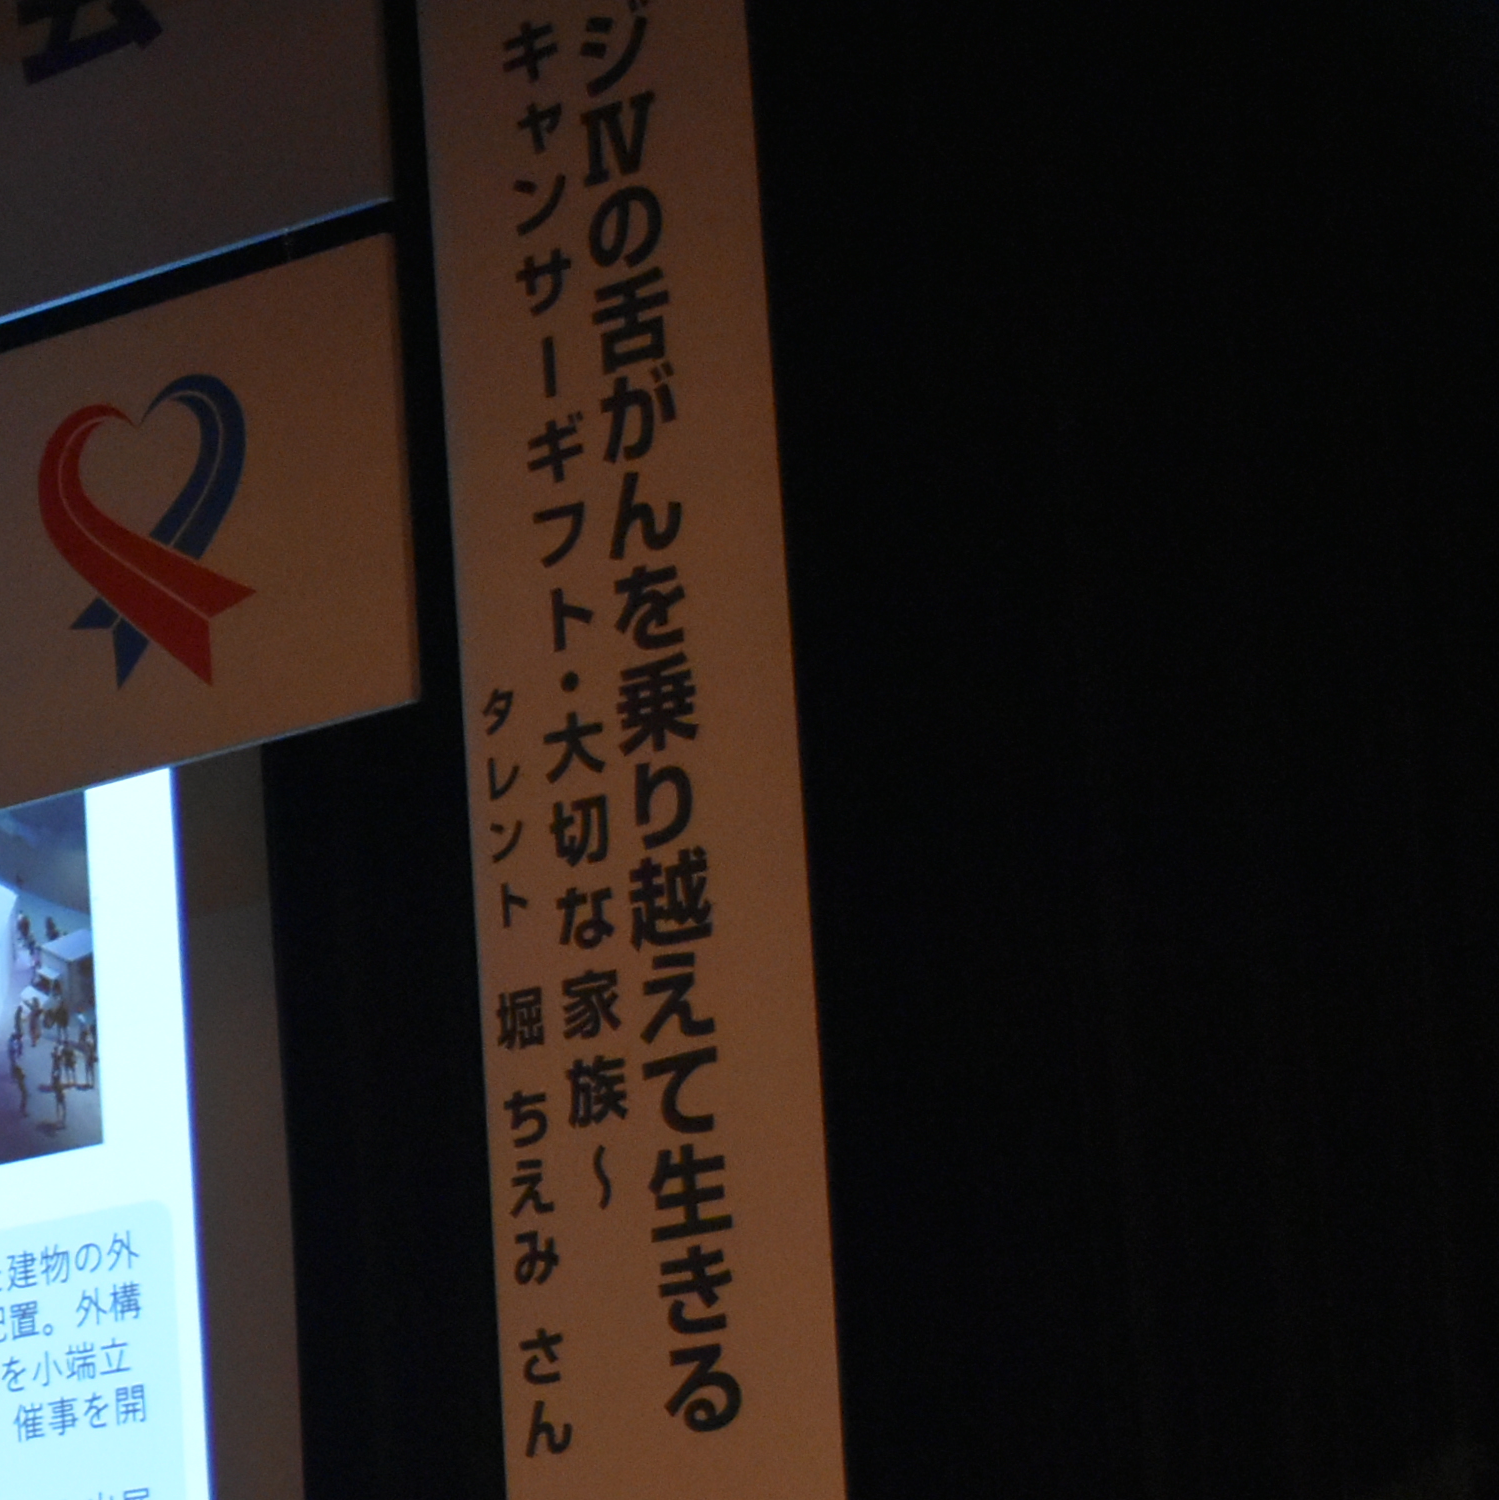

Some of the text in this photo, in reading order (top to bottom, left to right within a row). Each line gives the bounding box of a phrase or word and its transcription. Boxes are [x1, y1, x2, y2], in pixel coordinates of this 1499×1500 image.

[481, 687, 573, 1459] タレント 堀 ちえみ さん
